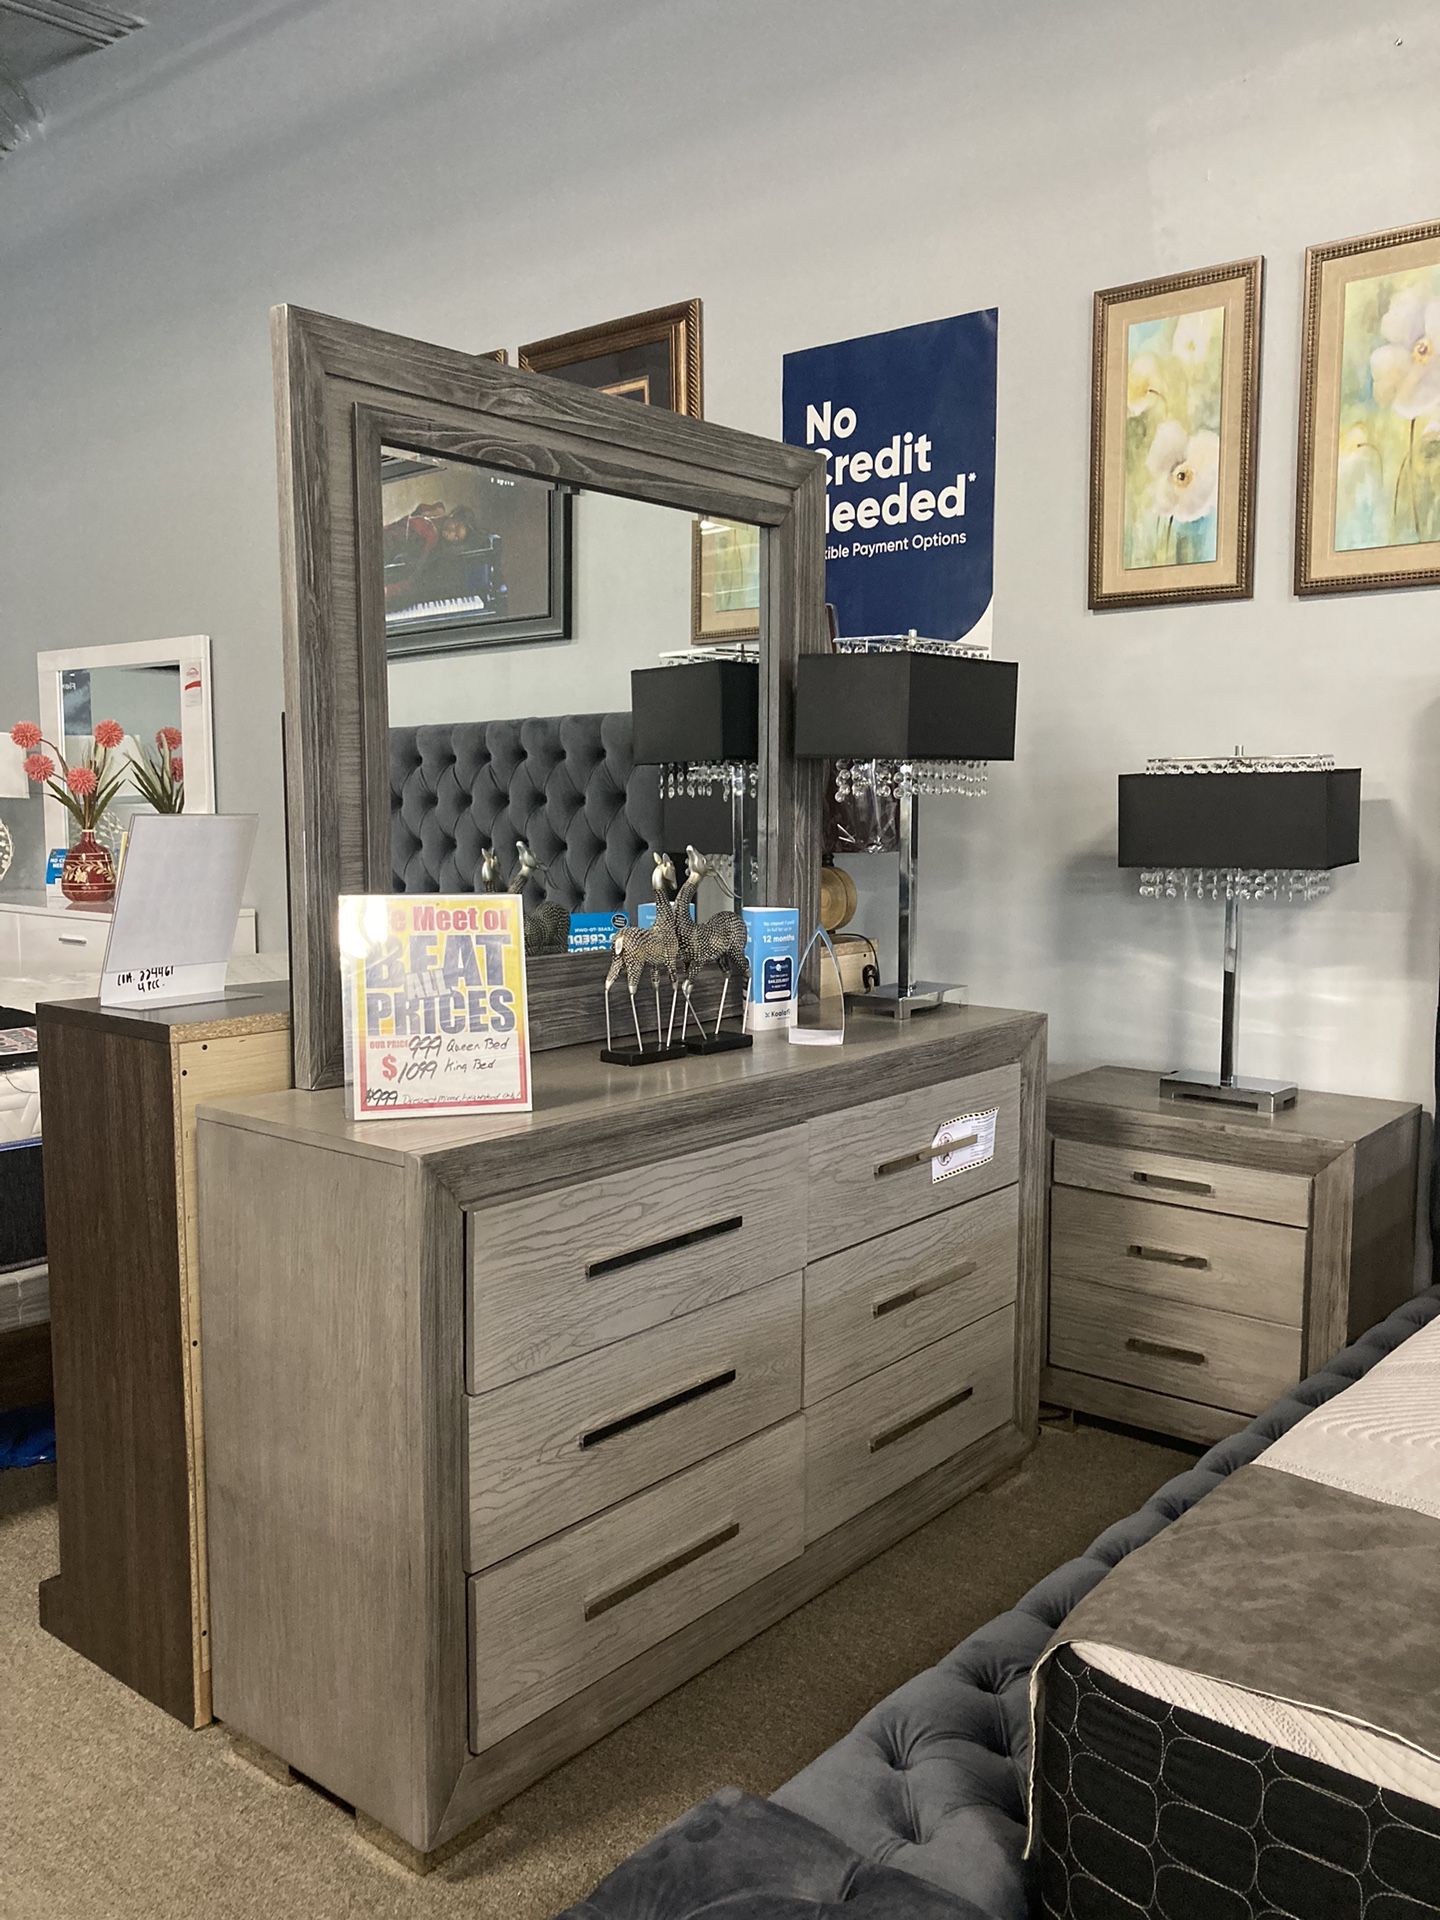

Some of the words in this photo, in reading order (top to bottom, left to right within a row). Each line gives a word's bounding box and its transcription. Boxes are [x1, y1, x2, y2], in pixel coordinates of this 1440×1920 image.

[806, 400, 857, 444] No
[825, 472, 977, 534] eeded
[852, 537, 908, 558] Payment
[912, 532, 966, 551] Options
[413, 906, 478, 931] Meet
[484, 909, 508, 931] or
[762, 935, 772, 943] 12
[773, 933, 795, 943] months
[366, 934, 511, 988] BEAT
[405, 968, 452, 1000] ALL
[366, 988, 516, 1036] PRICES
[370, 1040, 386, 1050] OUR
[409, 1035, 442, 1058] 999
[447, 1038, 481, 1052] Queen
[485, 1037, 511, 1050] Bed
[444, 1058, 468, 1072] King
[473, 1058, 496, 1070] Bed
[366, 1088, 398, 1105] $999
